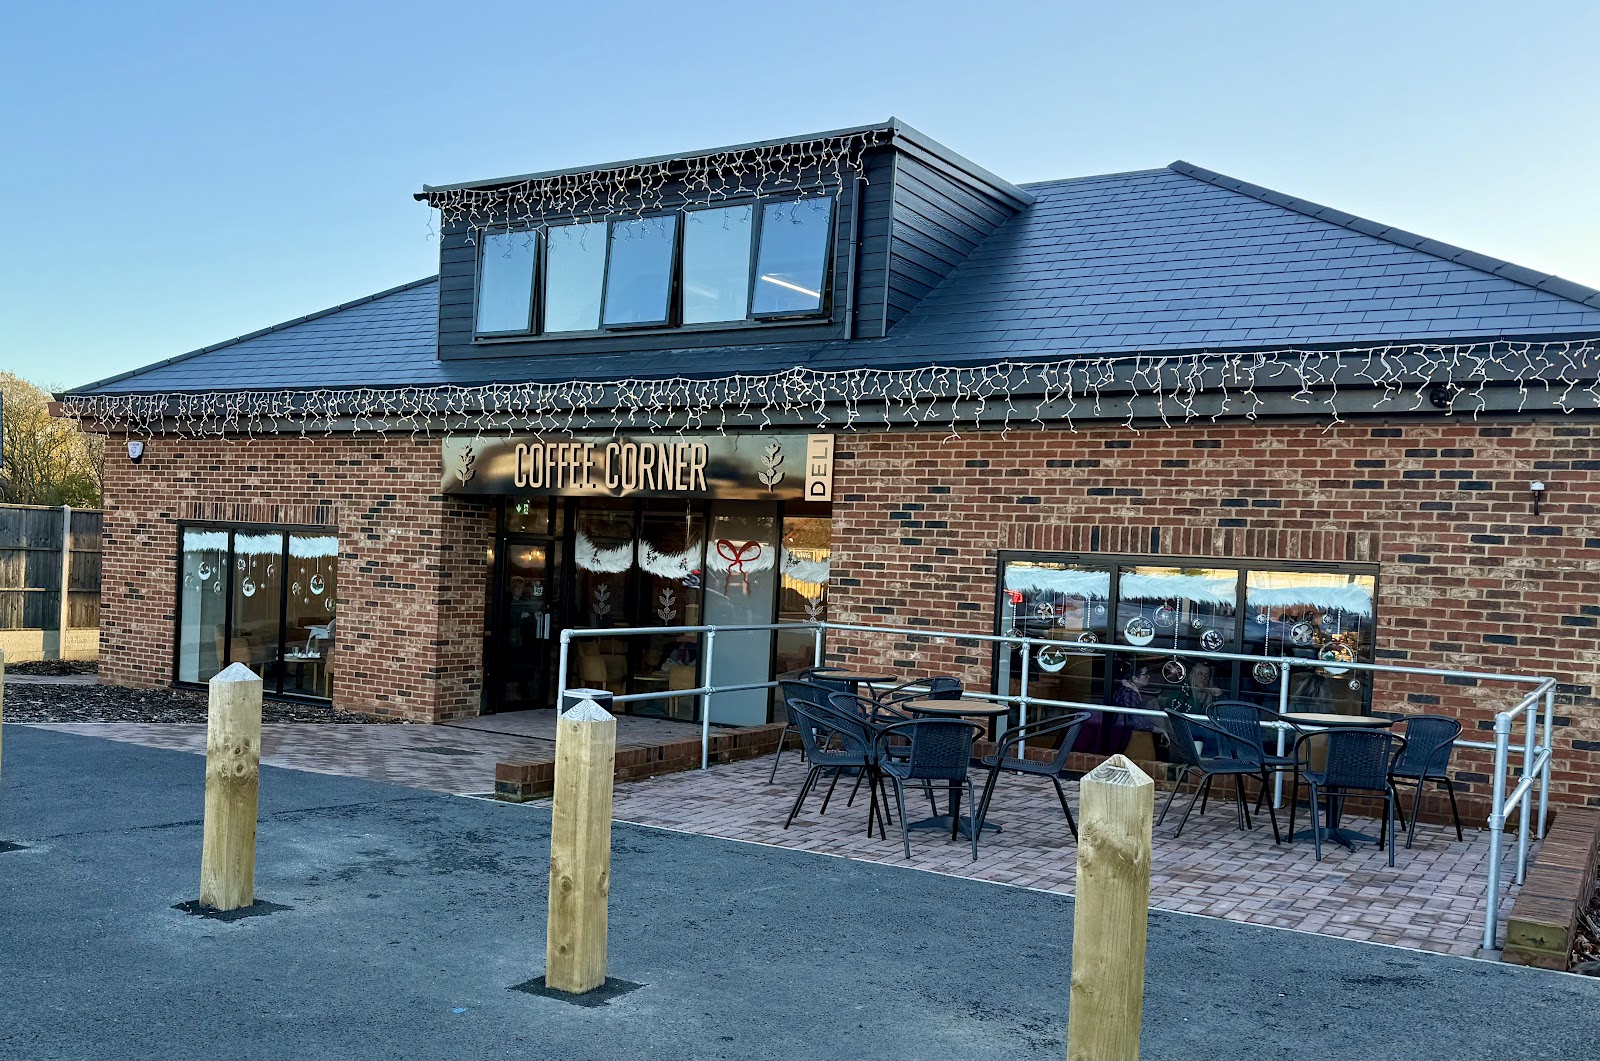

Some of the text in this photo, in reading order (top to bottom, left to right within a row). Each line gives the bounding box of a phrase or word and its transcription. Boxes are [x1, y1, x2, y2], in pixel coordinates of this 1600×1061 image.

[514, 443, 708, 491] COFFEE CORNER
[811, 439, 829, 496] DELI
